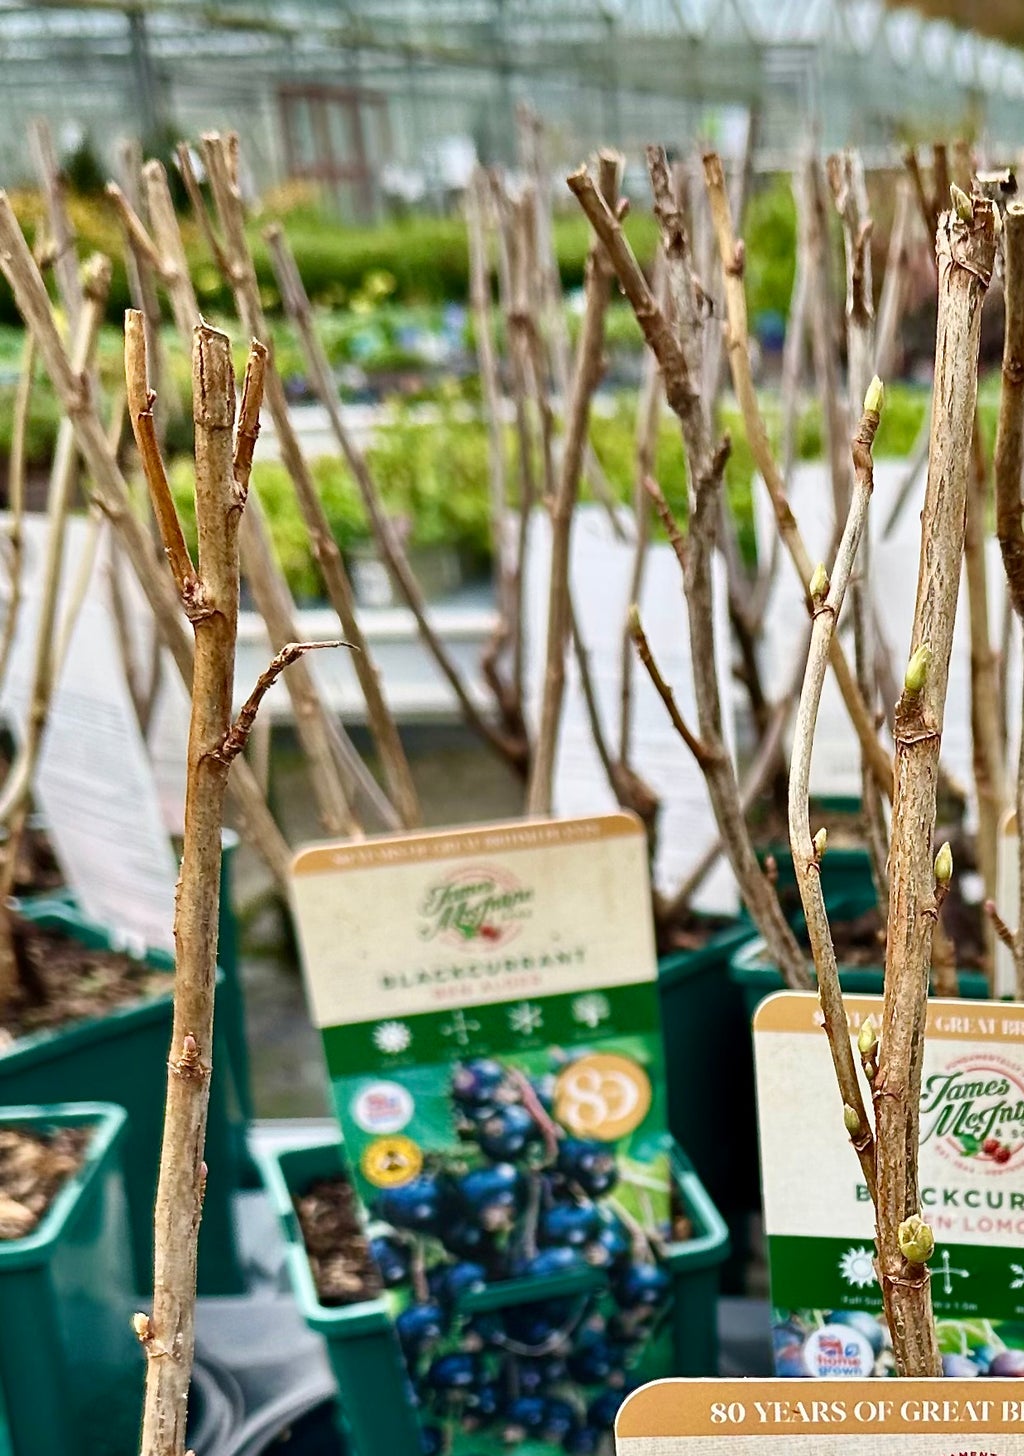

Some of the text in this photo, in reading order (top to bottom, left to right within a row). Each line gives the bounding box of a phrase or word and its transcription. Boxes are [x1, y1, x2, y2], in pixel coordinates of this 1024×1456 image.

[920, 1071, 1011, 1114] James
[817, 1353, 861, 1368] home
[710, 1402, 746, 1424] 80
[753, 1400, 847, 1423] YEARS
[854, 1401, 894, 1423] OF
[900, 1400, 995, 1422] GREAT
